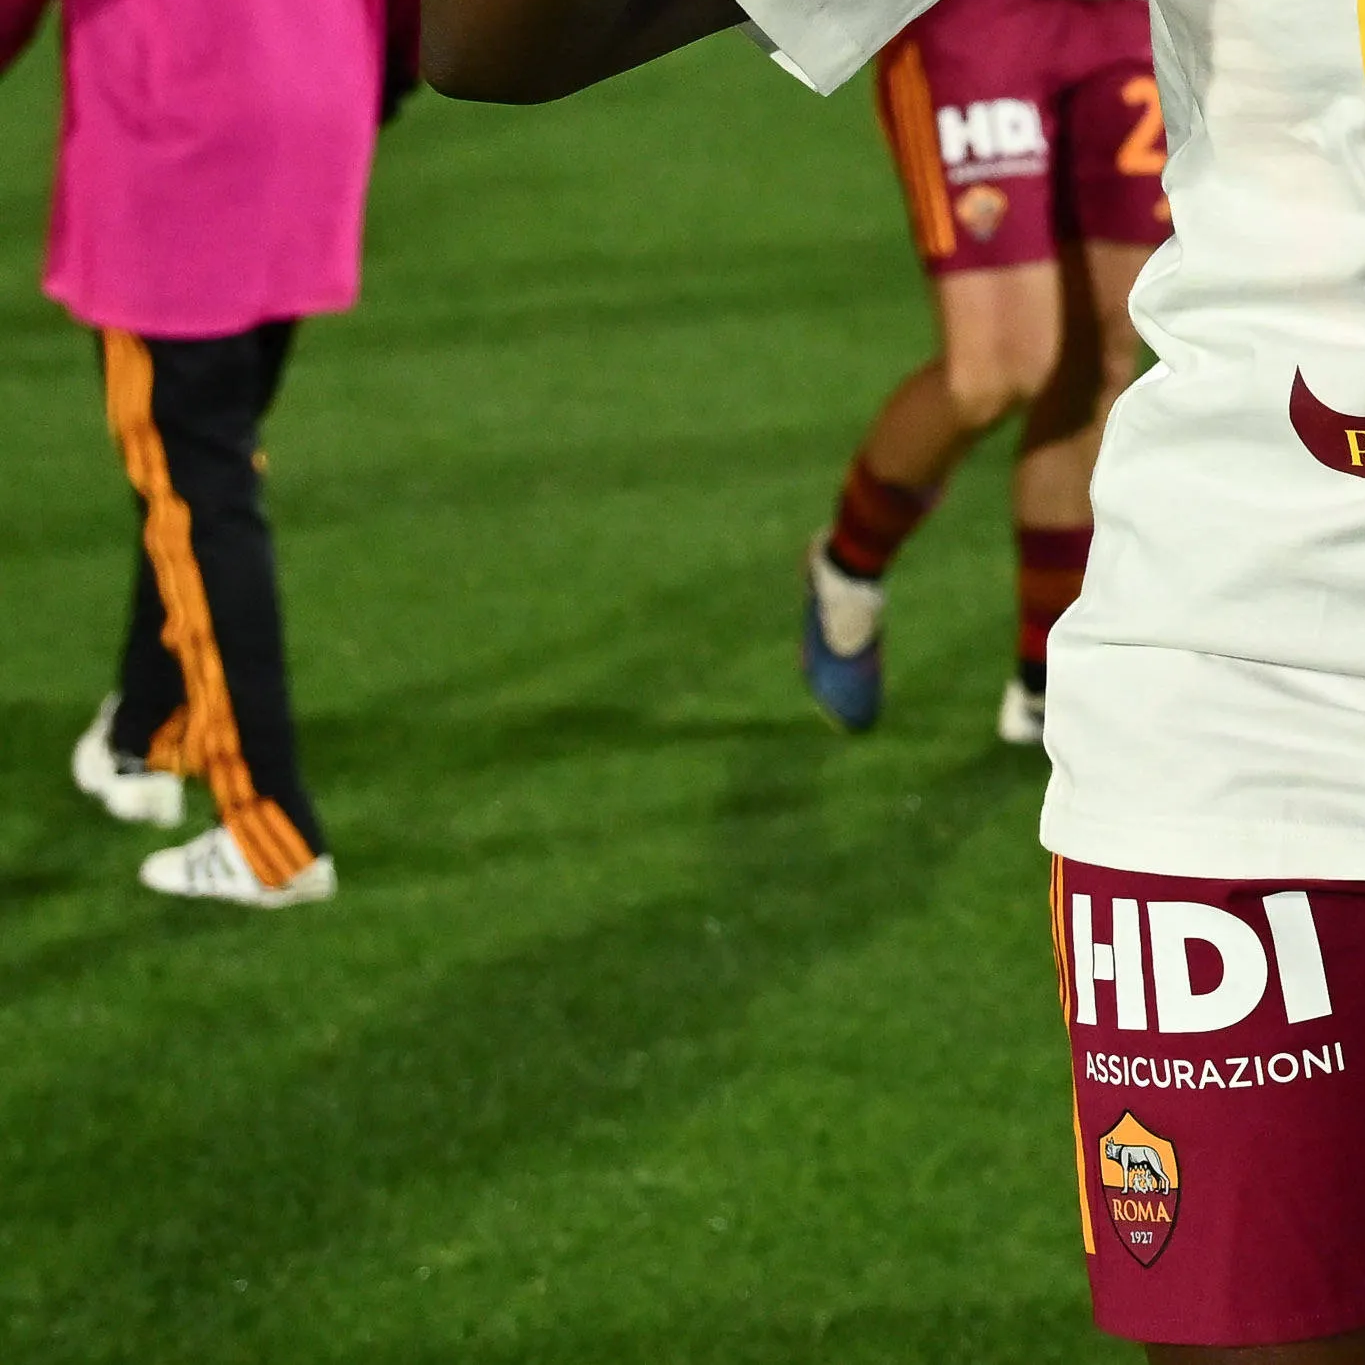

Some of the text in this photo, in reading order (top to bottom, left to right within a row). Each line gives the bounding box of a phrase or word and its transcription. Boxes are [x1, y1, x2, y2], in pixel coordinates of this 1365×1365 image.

[937, 99, 1049, 162] HD
[1072, 891, 1333, 1034] HDI
[1085, 1041, 1346, 1090] ASSICURAZIONI
[1111, 1198, 1173, 1223] ROMA
[1129, 1230, 1154, 1245] 1927
